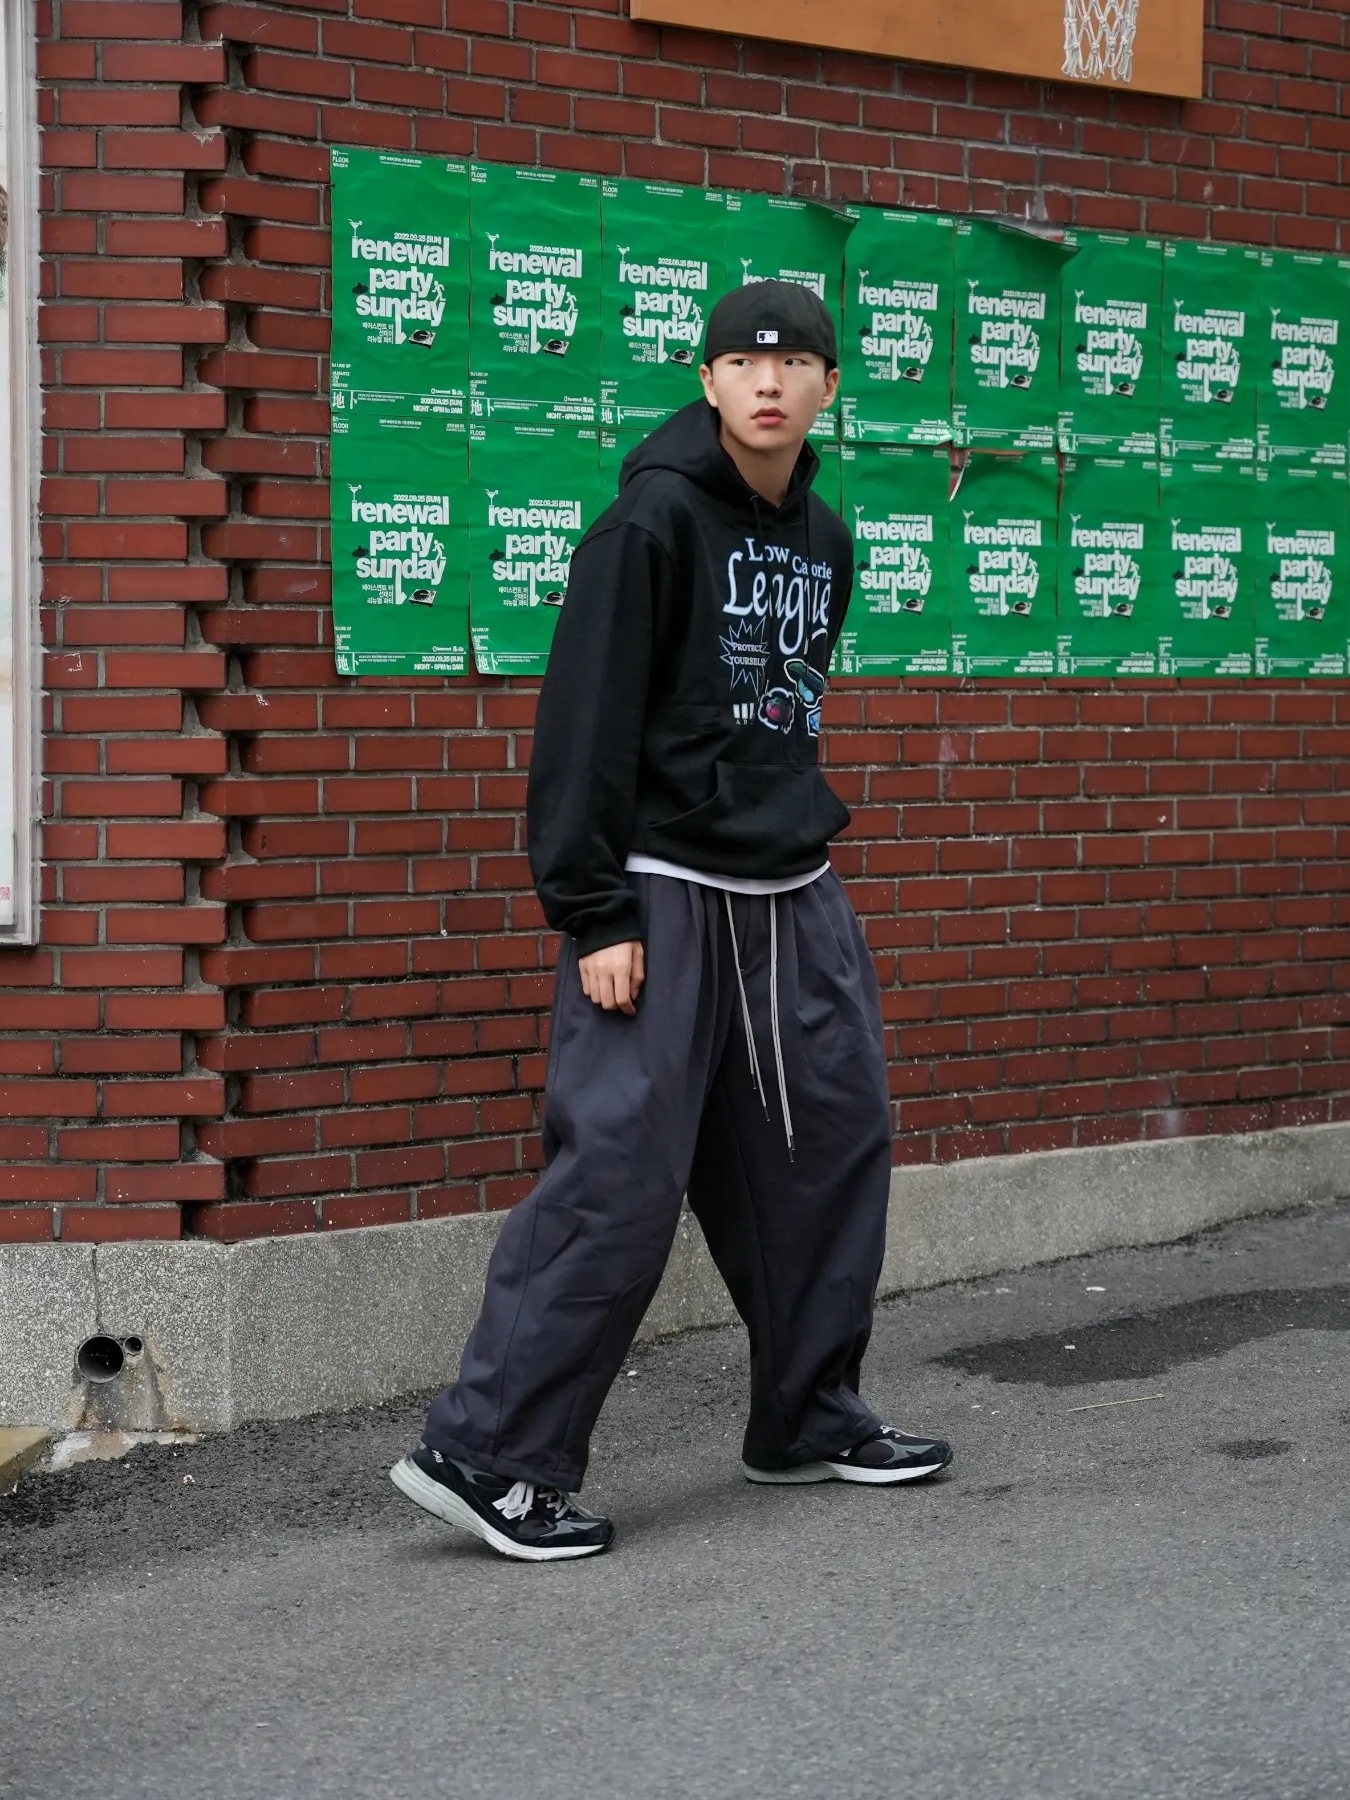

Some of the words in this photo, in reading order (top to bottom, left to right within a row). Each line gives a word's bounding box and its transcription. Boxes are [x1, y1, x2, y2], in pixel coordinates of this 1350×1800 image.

[352, 237, 449, 267] renewal
[490, 249, 582, 278] renewal
[370, 266, 434, 298] party
[620, 262, 707, 290] renewal
[506, 277, 567, 309] party
[635, 289, 693, 320] party
[859, 283, 937, 310] renewal
[969, 293, 1044, 319] renewal
[356, 292, 446, 327] sunday
[493, 303, 579, 336] sunday
[1075, 303, 1147, 328] renewal
[623, 314, 704, 346] sunday
[872, 310, 923, 339] party
[982, 319, 1031, 347] party
[1175, 311, 1244, 337] renewal
[1272, 320, 1337, 344] renewal
[861, 334, 933, 364] sunday
[1088, 328, 1134, 356] party
[1187, 336, 1232, 363] party
[971, 342, 1040, 372] sunday
[1077, 351, 1143, 380] sunday
[1282, 344, 1326, 371] party
[1177, 358, 1240, 387] sunday
[1273, 366, 1334, 394] sunday
[413, 404, 430, 412] NIGHT
[352, 496, 449, 525] renewal
[489, 500, 581, 529] renewal
[370, 526, 434, 558] party
[855, 515, 933, 541] renewal
[965, 520, 1041, 546] renewal
[1072, 523, 1143, 549] renewal
[1172, 527, 1240, 552] renewal
[506, 530, 566, 561] party
[870, 542, 921, 571] party
[1268, 531, 1334, 555] renewal
[356, 552, 446, 585] sunday
[493, 556, 569, 588] sunday
[979, 546, 1029, 574] party
[1085, 549, 1131, 577] party
[1185, 553, 1230, 580] party
[1280, 556, 1323, 582] party
[860, 566, 932, 595] sunday
[969, 570, 1039, 598] sunday
[1075, 572, 1140, 600] sunday
[1175, 575, 1238, 602] sunday
[1271, 577, 1332, 604] sunday
[732, 642, 763, 653] PROTECT
